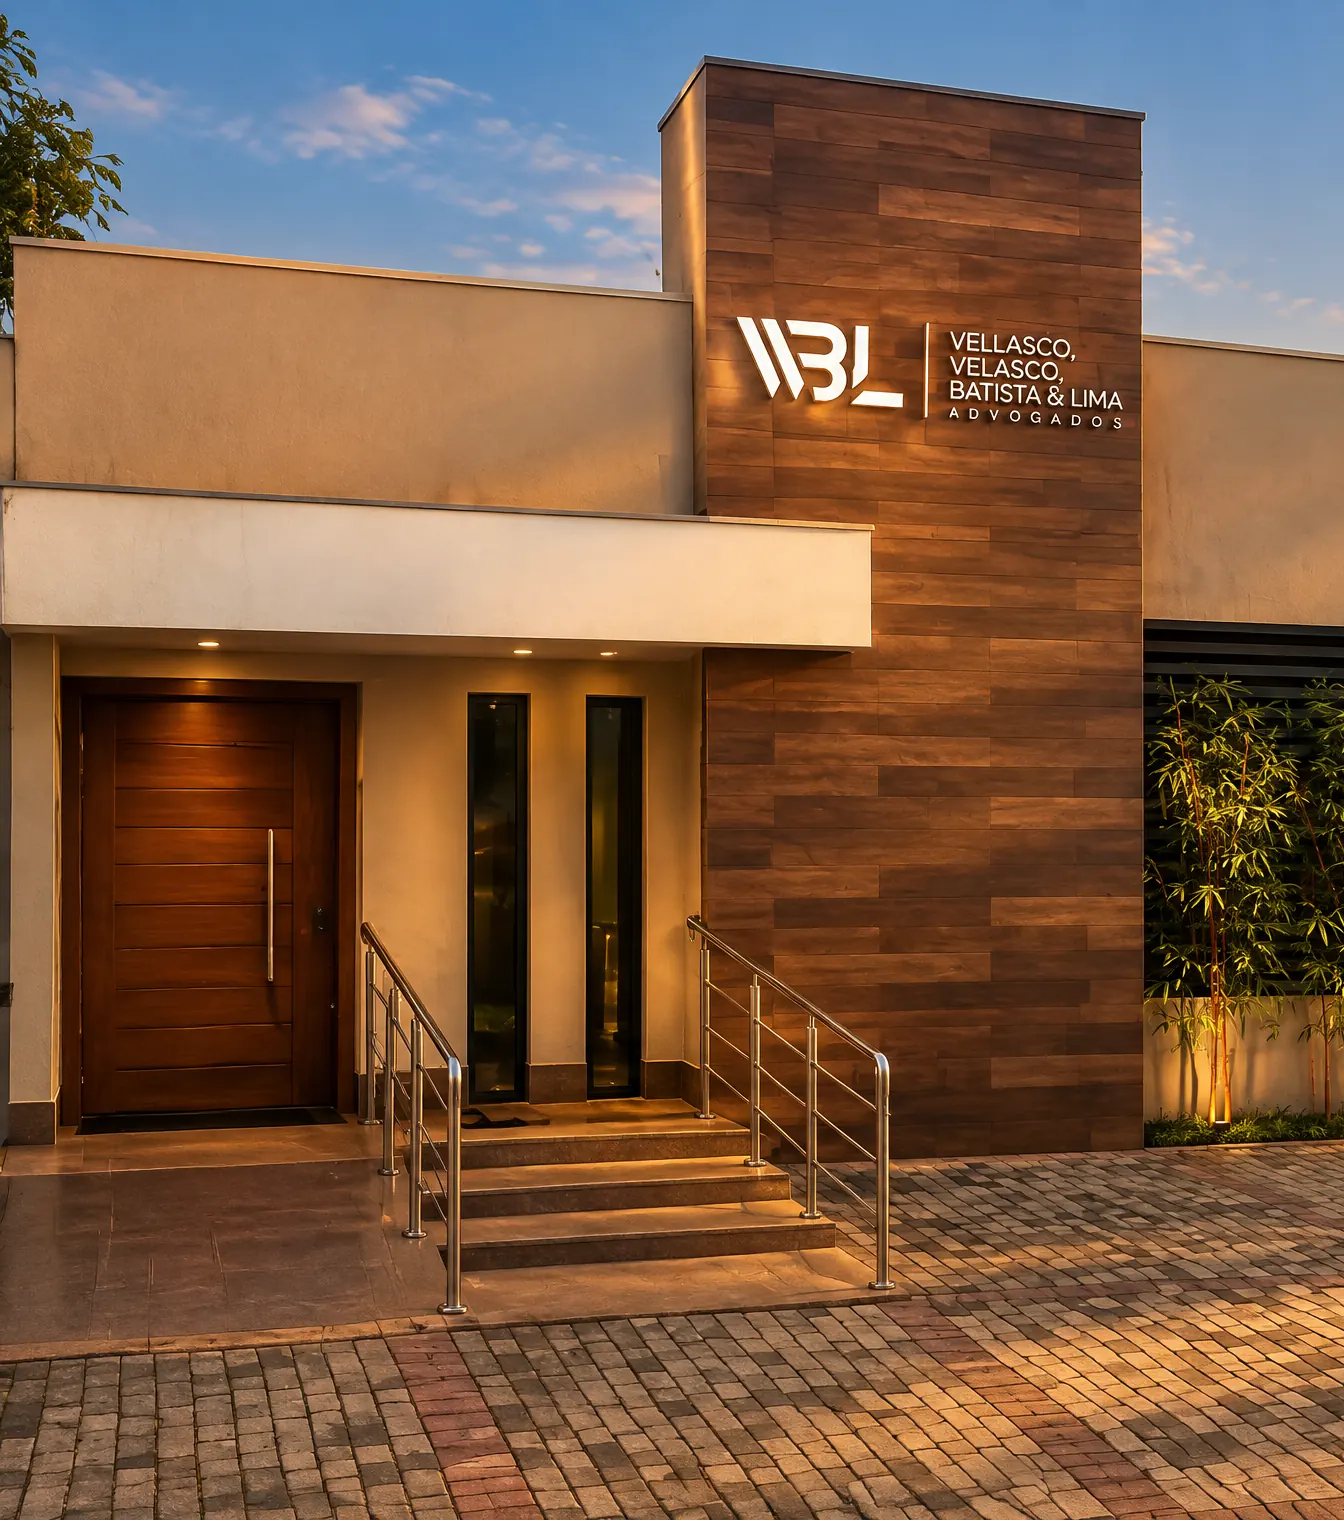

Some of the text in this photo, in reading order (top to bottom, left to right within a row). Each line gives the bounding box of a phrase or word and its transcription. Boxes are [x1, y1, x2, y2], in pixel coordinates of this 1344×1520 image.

[949, 330, 1077, 362] VELLASCO,
[949, 355, 1065, 385] VELASCO,
[949, 379, 1124, 411] BATISTA & LIMA
[948, 406, 1123, 430] ADVOGADOS
